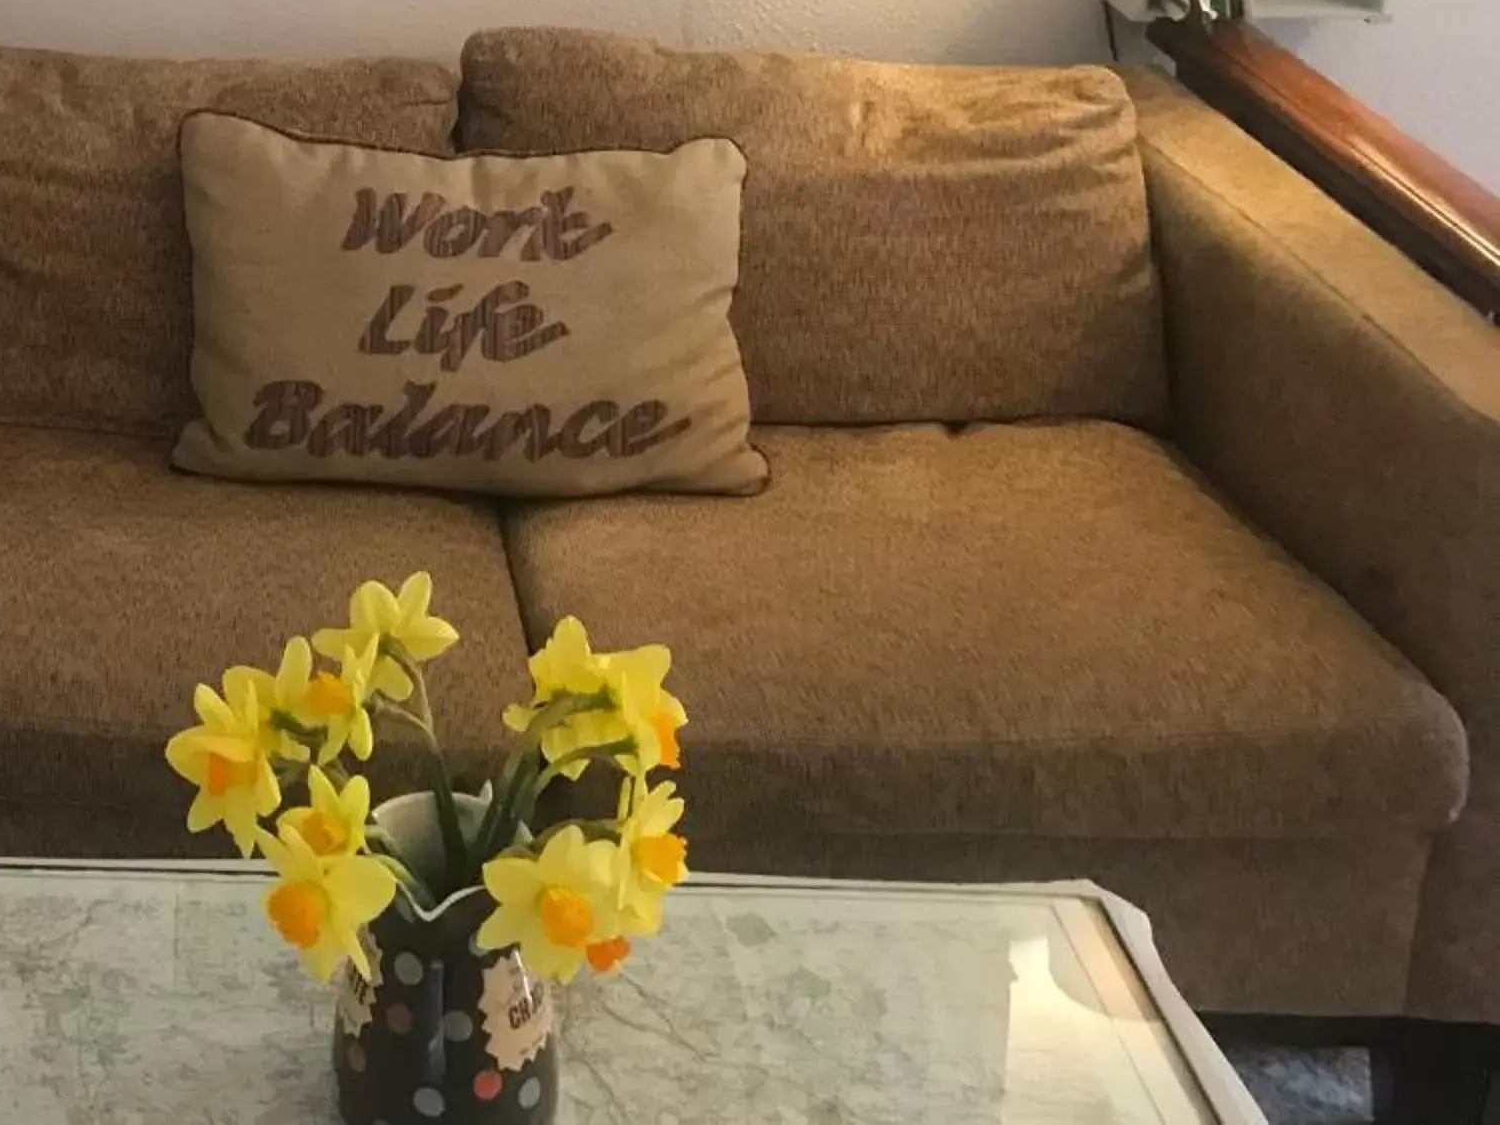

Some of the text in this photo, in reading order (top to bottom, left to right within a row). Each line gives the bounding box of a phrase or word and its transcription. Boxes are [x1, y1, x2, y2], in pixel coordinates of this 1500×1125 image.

[341, 185, 613, 263] Work
[358, 279, 570, 374] Life
[244, 379, 693, 462] Balance
